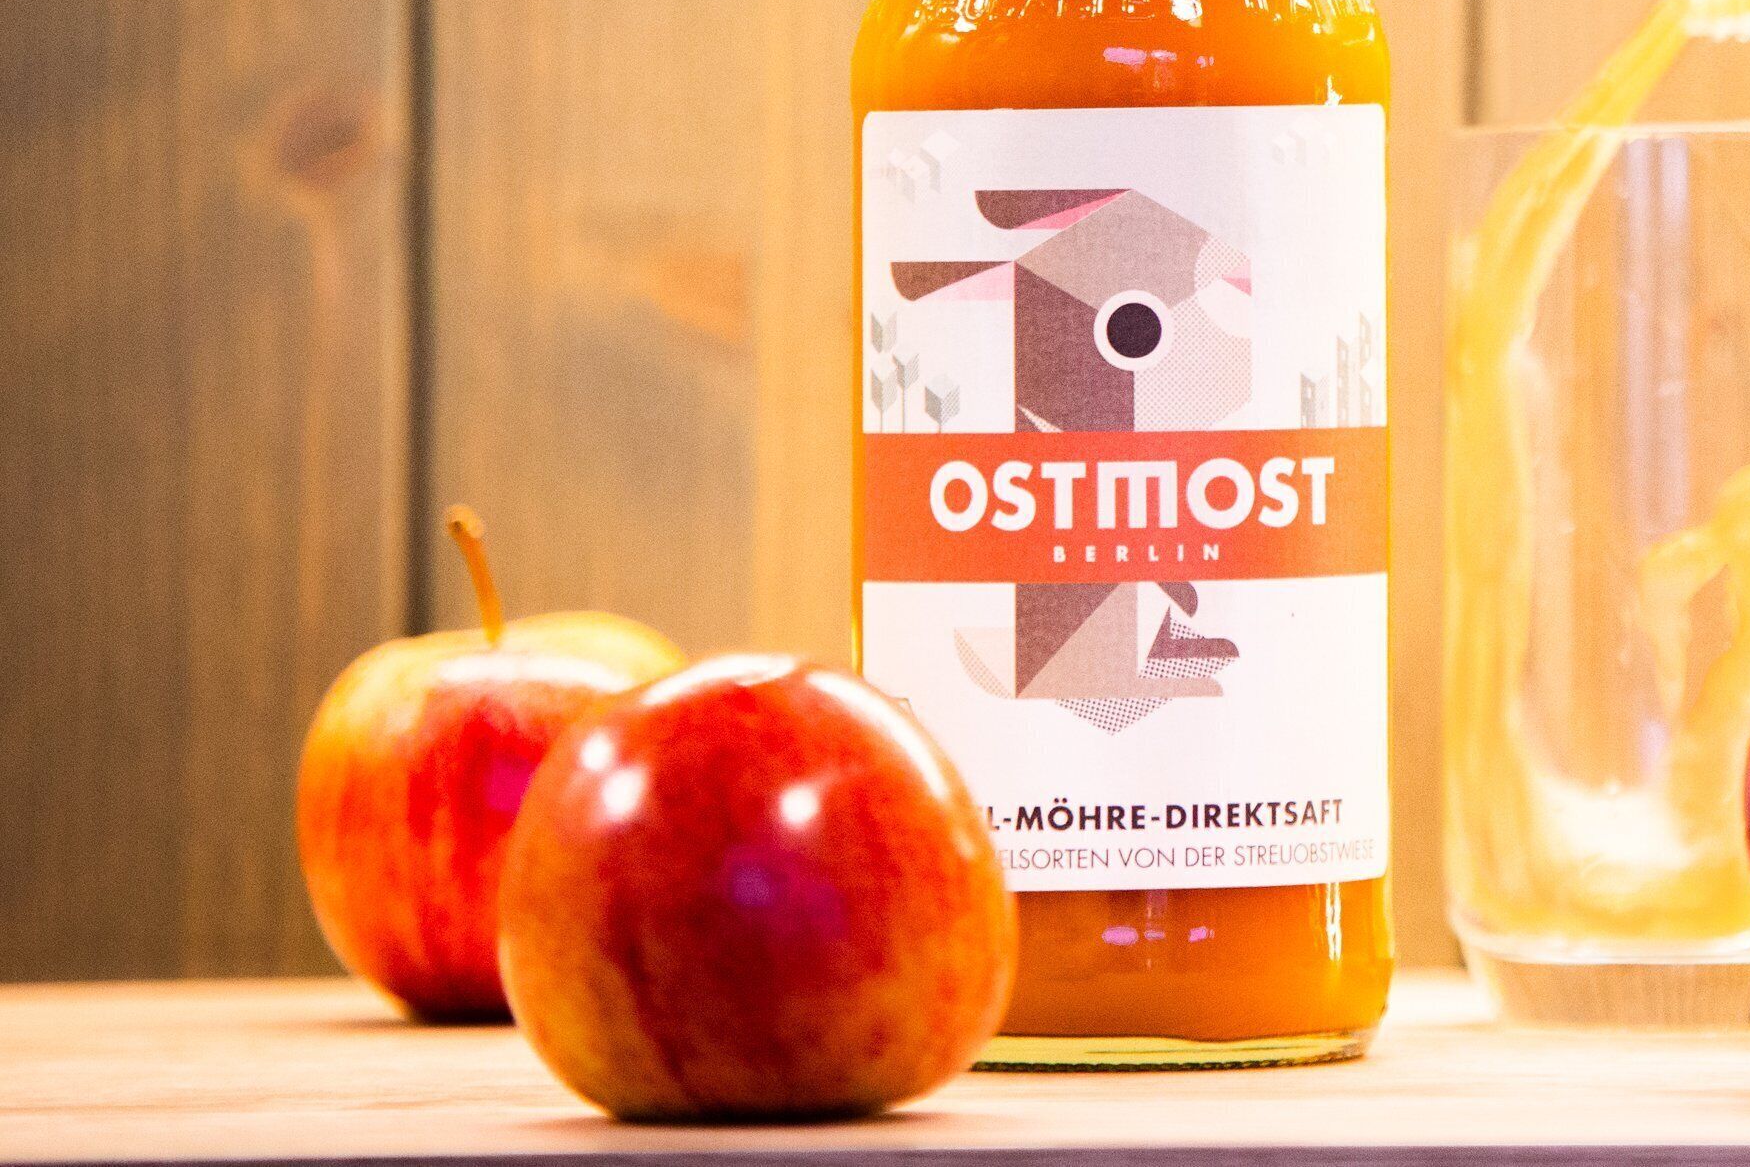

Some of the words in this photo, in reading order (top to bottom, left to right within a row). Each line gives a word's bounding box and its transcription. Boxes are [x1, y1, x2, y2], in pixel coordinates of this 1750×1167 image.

[929, 457, 1335, 532] OSTMOST
[1053, 543, 1220, 564] BERLIN
[986, 797, 1343, 831] L-MÖHRE-DIREKTSAFT
[998, 847, 1109, 870] ELSORTEN
[1118, 847, 1176, 868] VON
[1185, 844, 1225, 867] DER
[1233, 838, 1375, 867] STREUOBSTWIESE
